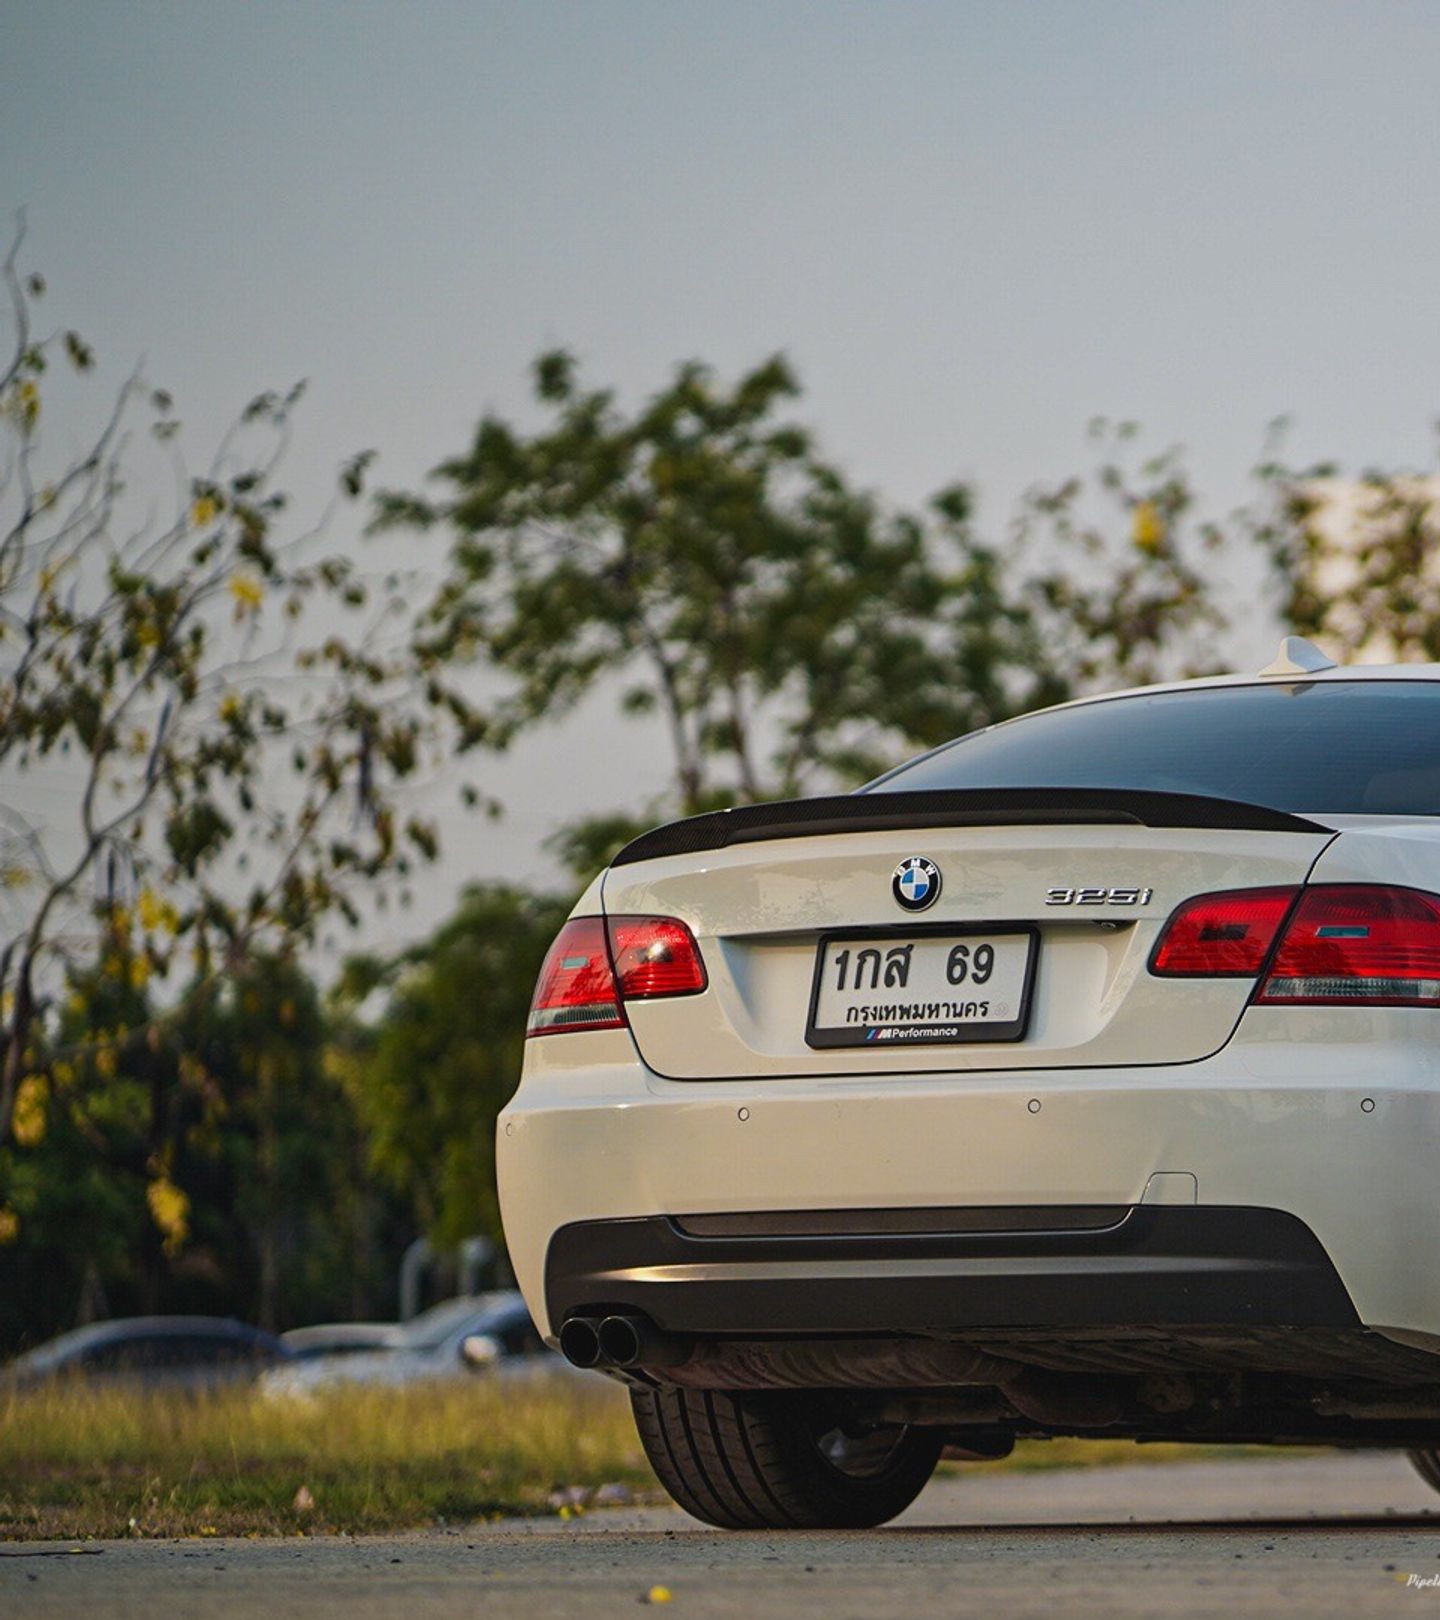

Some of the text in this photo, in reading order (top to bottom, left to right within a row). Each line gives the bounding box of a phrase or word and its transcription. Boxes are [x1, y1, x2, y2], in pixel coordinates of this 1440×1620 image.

[1045, 887, 1153, 906] 325i
[835, 943, 995, 990] 1กส 69
[846, 1001, 990, 1027] กรุงเทพมหานคร
